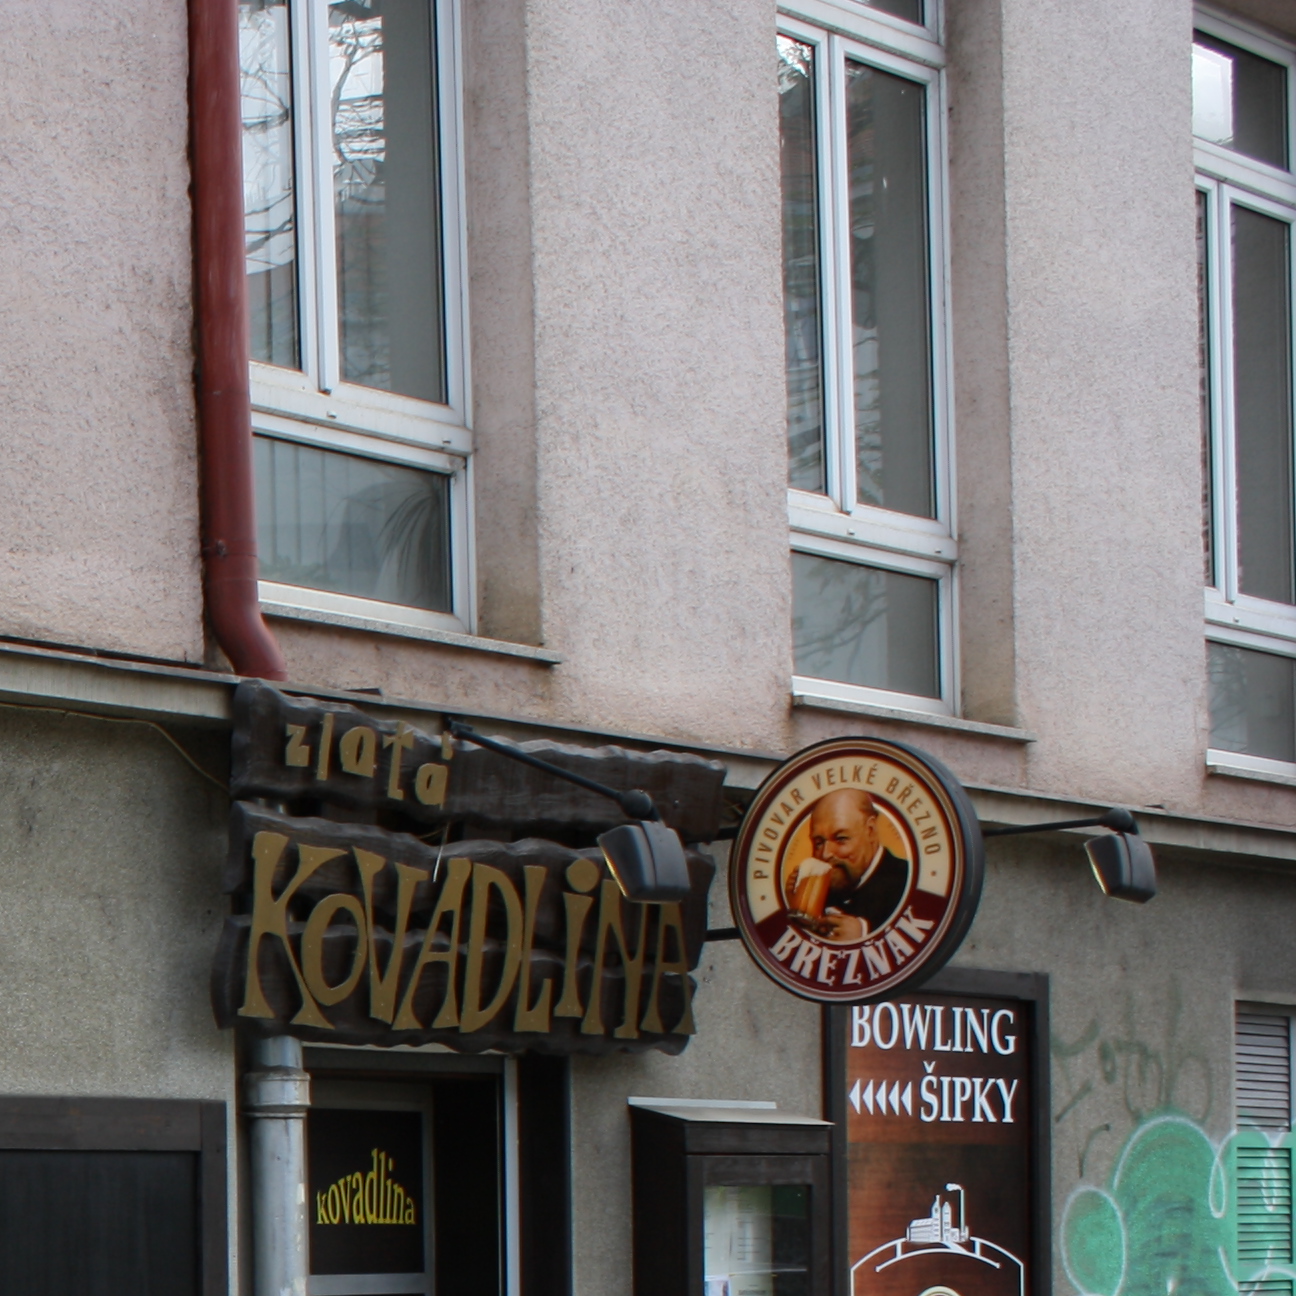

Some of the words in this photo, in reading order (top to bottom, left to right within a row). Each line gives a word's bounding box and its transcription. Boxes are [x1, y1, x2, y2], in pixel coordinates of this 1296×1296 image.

[754, 788, 805, 880] PIVOVAR
[811, 763, 877, 790] VELKÉ
[885, 777, 941, 855] BŘEZNO
[769, 905, 935, 986] BŘEZŇÁK
[851, 1002, 1016, 1055] BOWLING
[920, 1060, 1019, 1124] ŠIPKY
[316, 1148, 417, 1225] kovadlina
